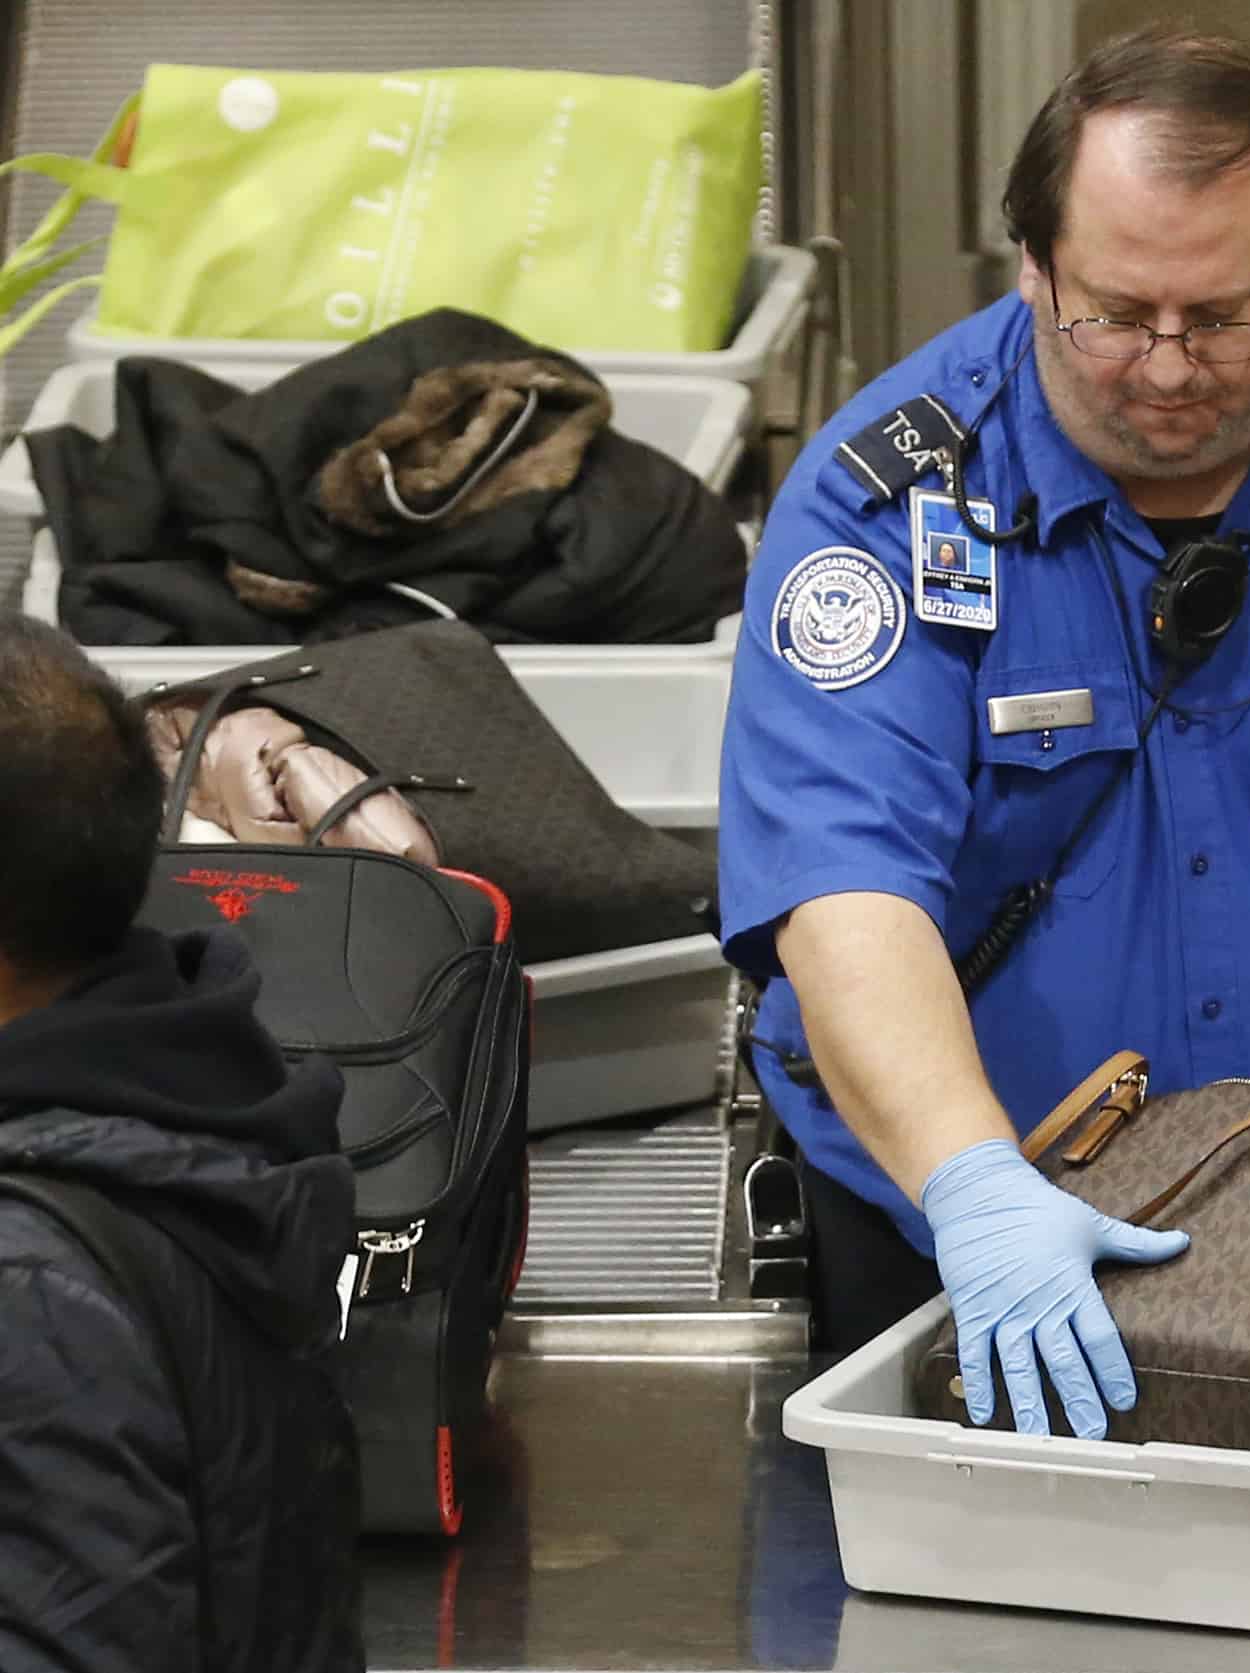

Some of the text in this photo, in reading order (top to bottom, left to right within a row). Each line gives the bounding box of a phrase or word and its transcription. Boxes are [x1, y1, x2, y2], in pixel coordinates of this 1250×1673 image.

[883, 410, 932, 472] TSA
[780, 557, 869, 620] TRANSPORTATION
[866, 570, 896, 629] SECURITY
[783, 648, 876, 680] ADMINISTRATION
